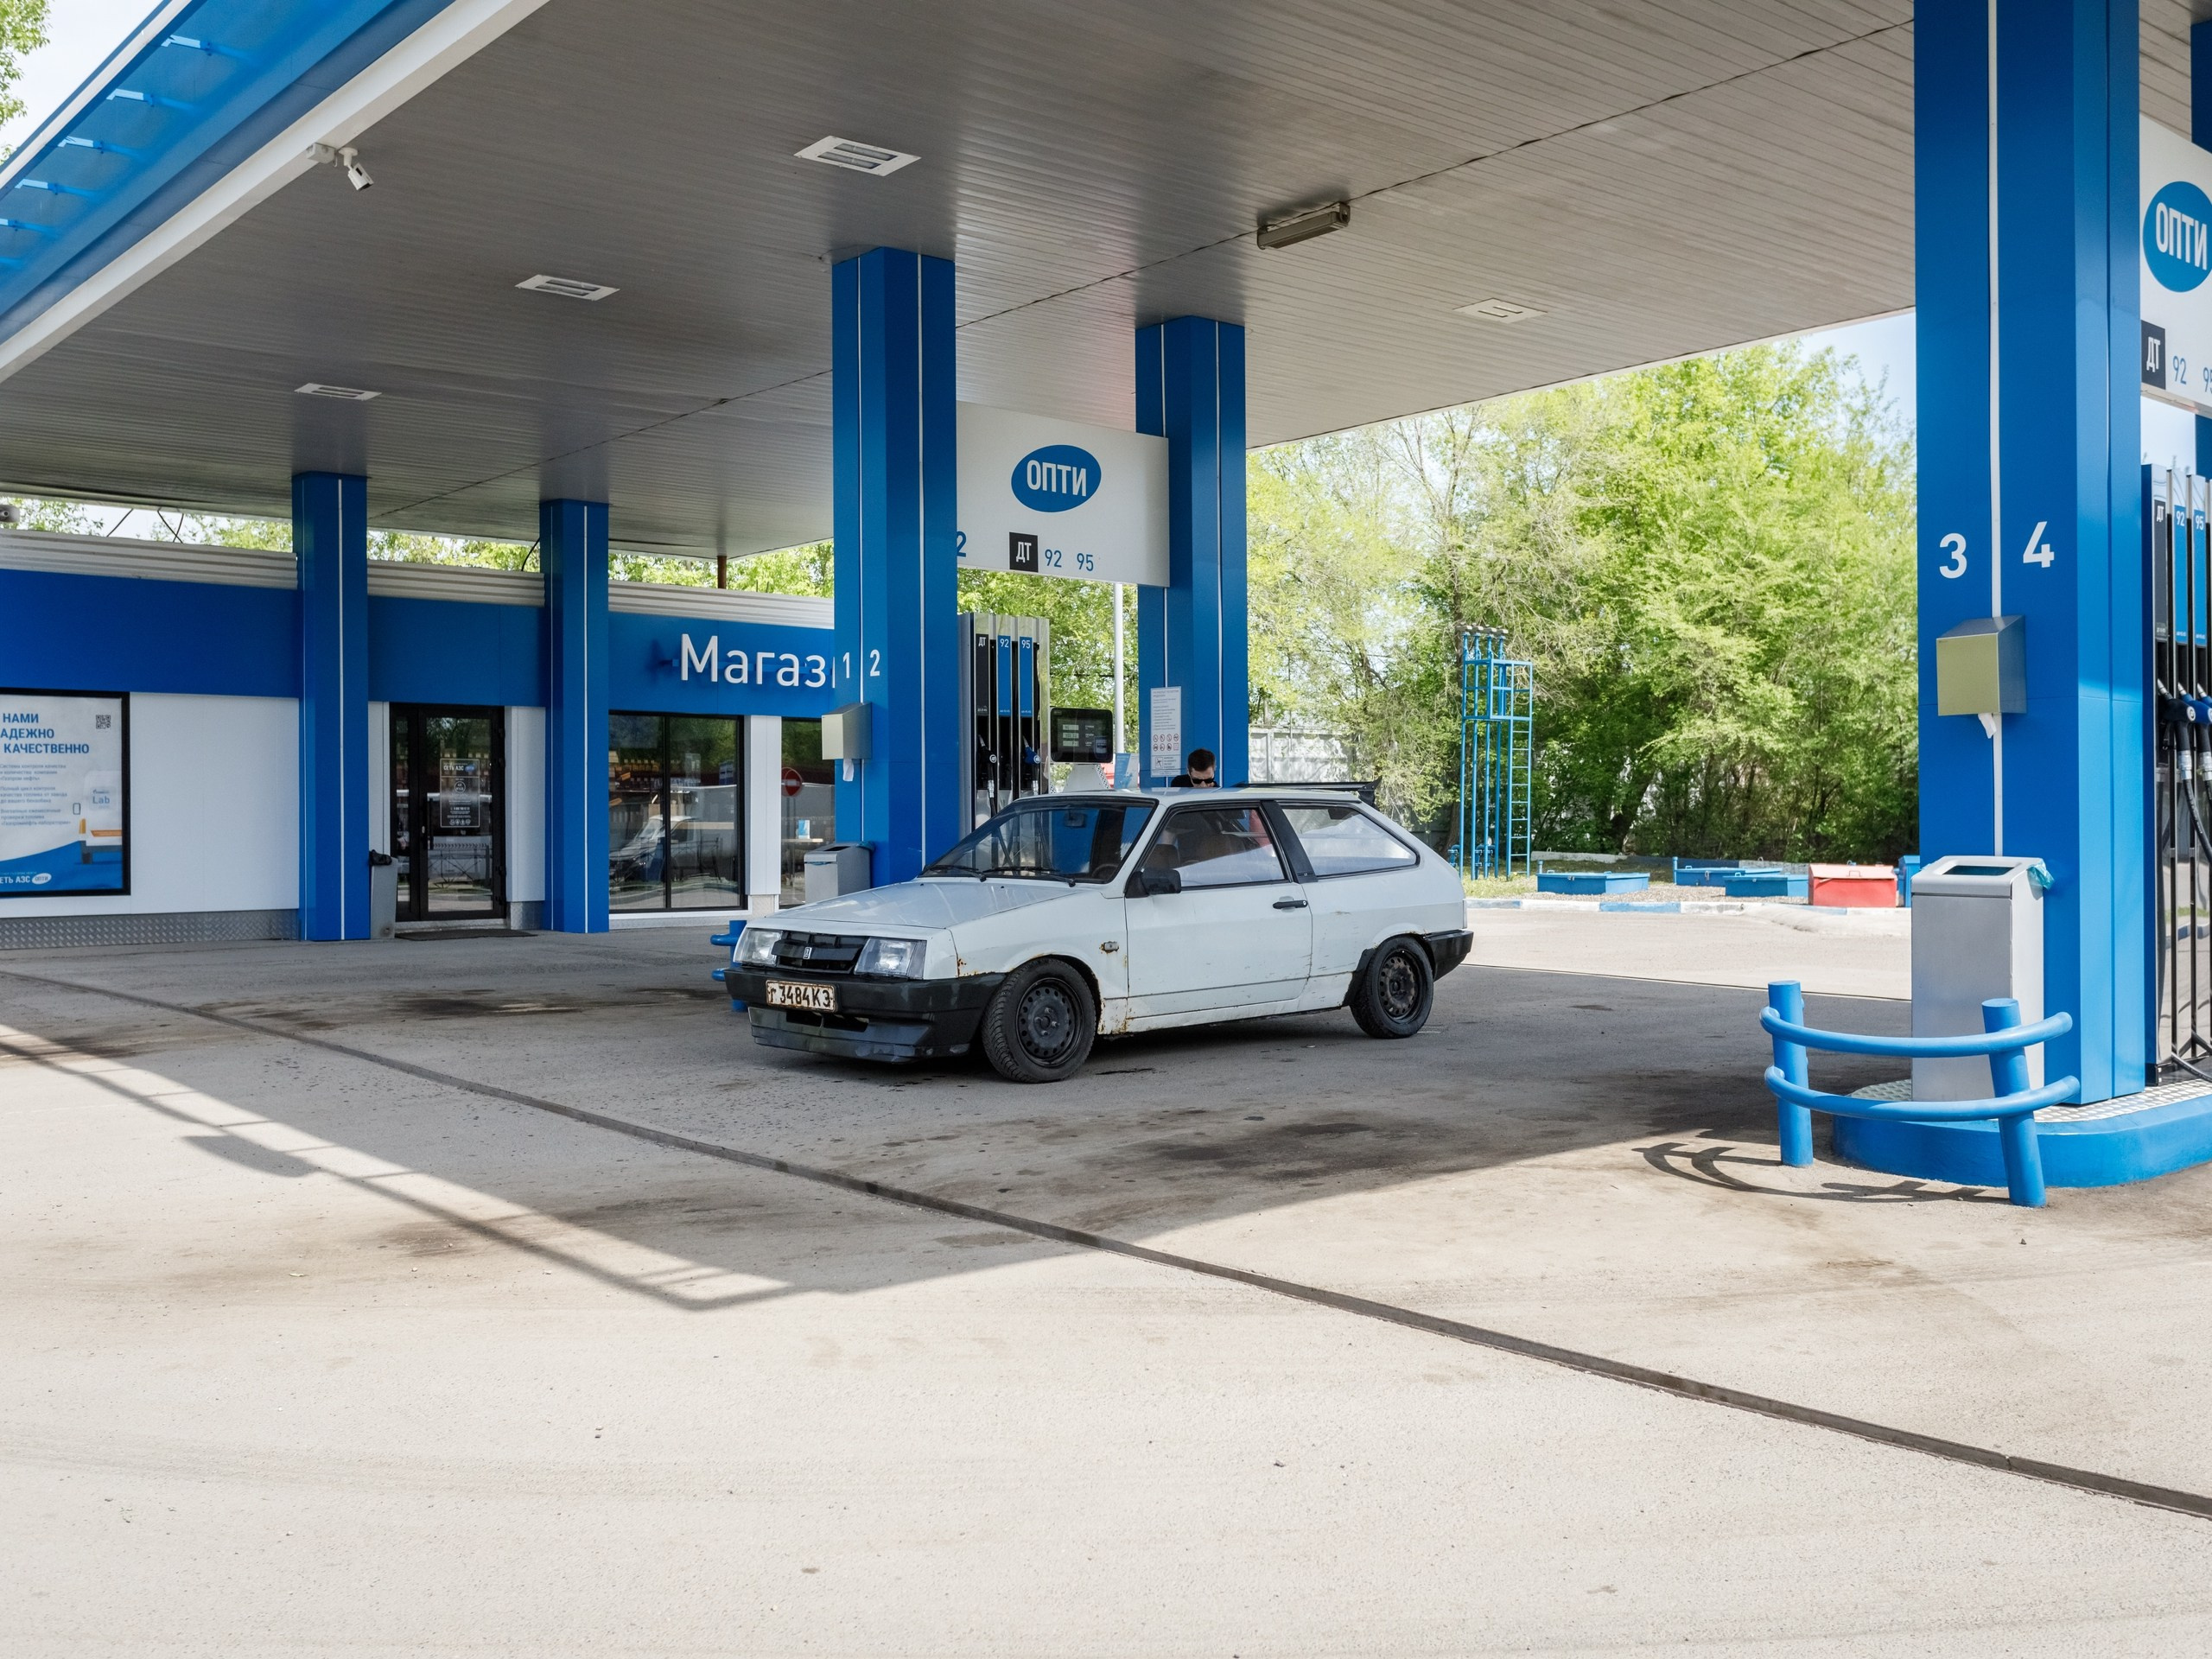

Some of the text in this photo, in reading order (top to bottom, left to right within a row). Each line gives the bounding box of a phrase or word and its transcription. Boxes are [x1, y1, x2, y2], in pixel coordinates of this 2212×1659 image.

[2155, 201, 2208, 270] ОПТИ
[2146, 336, 2161, 372] ДТ
[2172, 355, 2187, 385] 92
[1026, 459, 1087, 497] ОПТИ
[2156, 505, 2204, 531] ДТ 92 95
[1015, 542, 1095, 572] ДТ 92 95
[1939, 532, 1967, 579] 3
[2022, 520, 2055, 569] 4
[978, 636, 1031, 649] ДТ 92 95
[680, 633, 836, 689] Магаз
[842, 652, 850, 679] 1
[869, 649, 881, 677] 2
[3, 713, 40, 723] НАМИ
[0, 728, 55, 741] АДЕЖНО
[3, 743, 90, 754] КАЧЕСТВЕННО
[92, 795, 111, 804] Lab
[16, 875, 31, 884] АЗС
